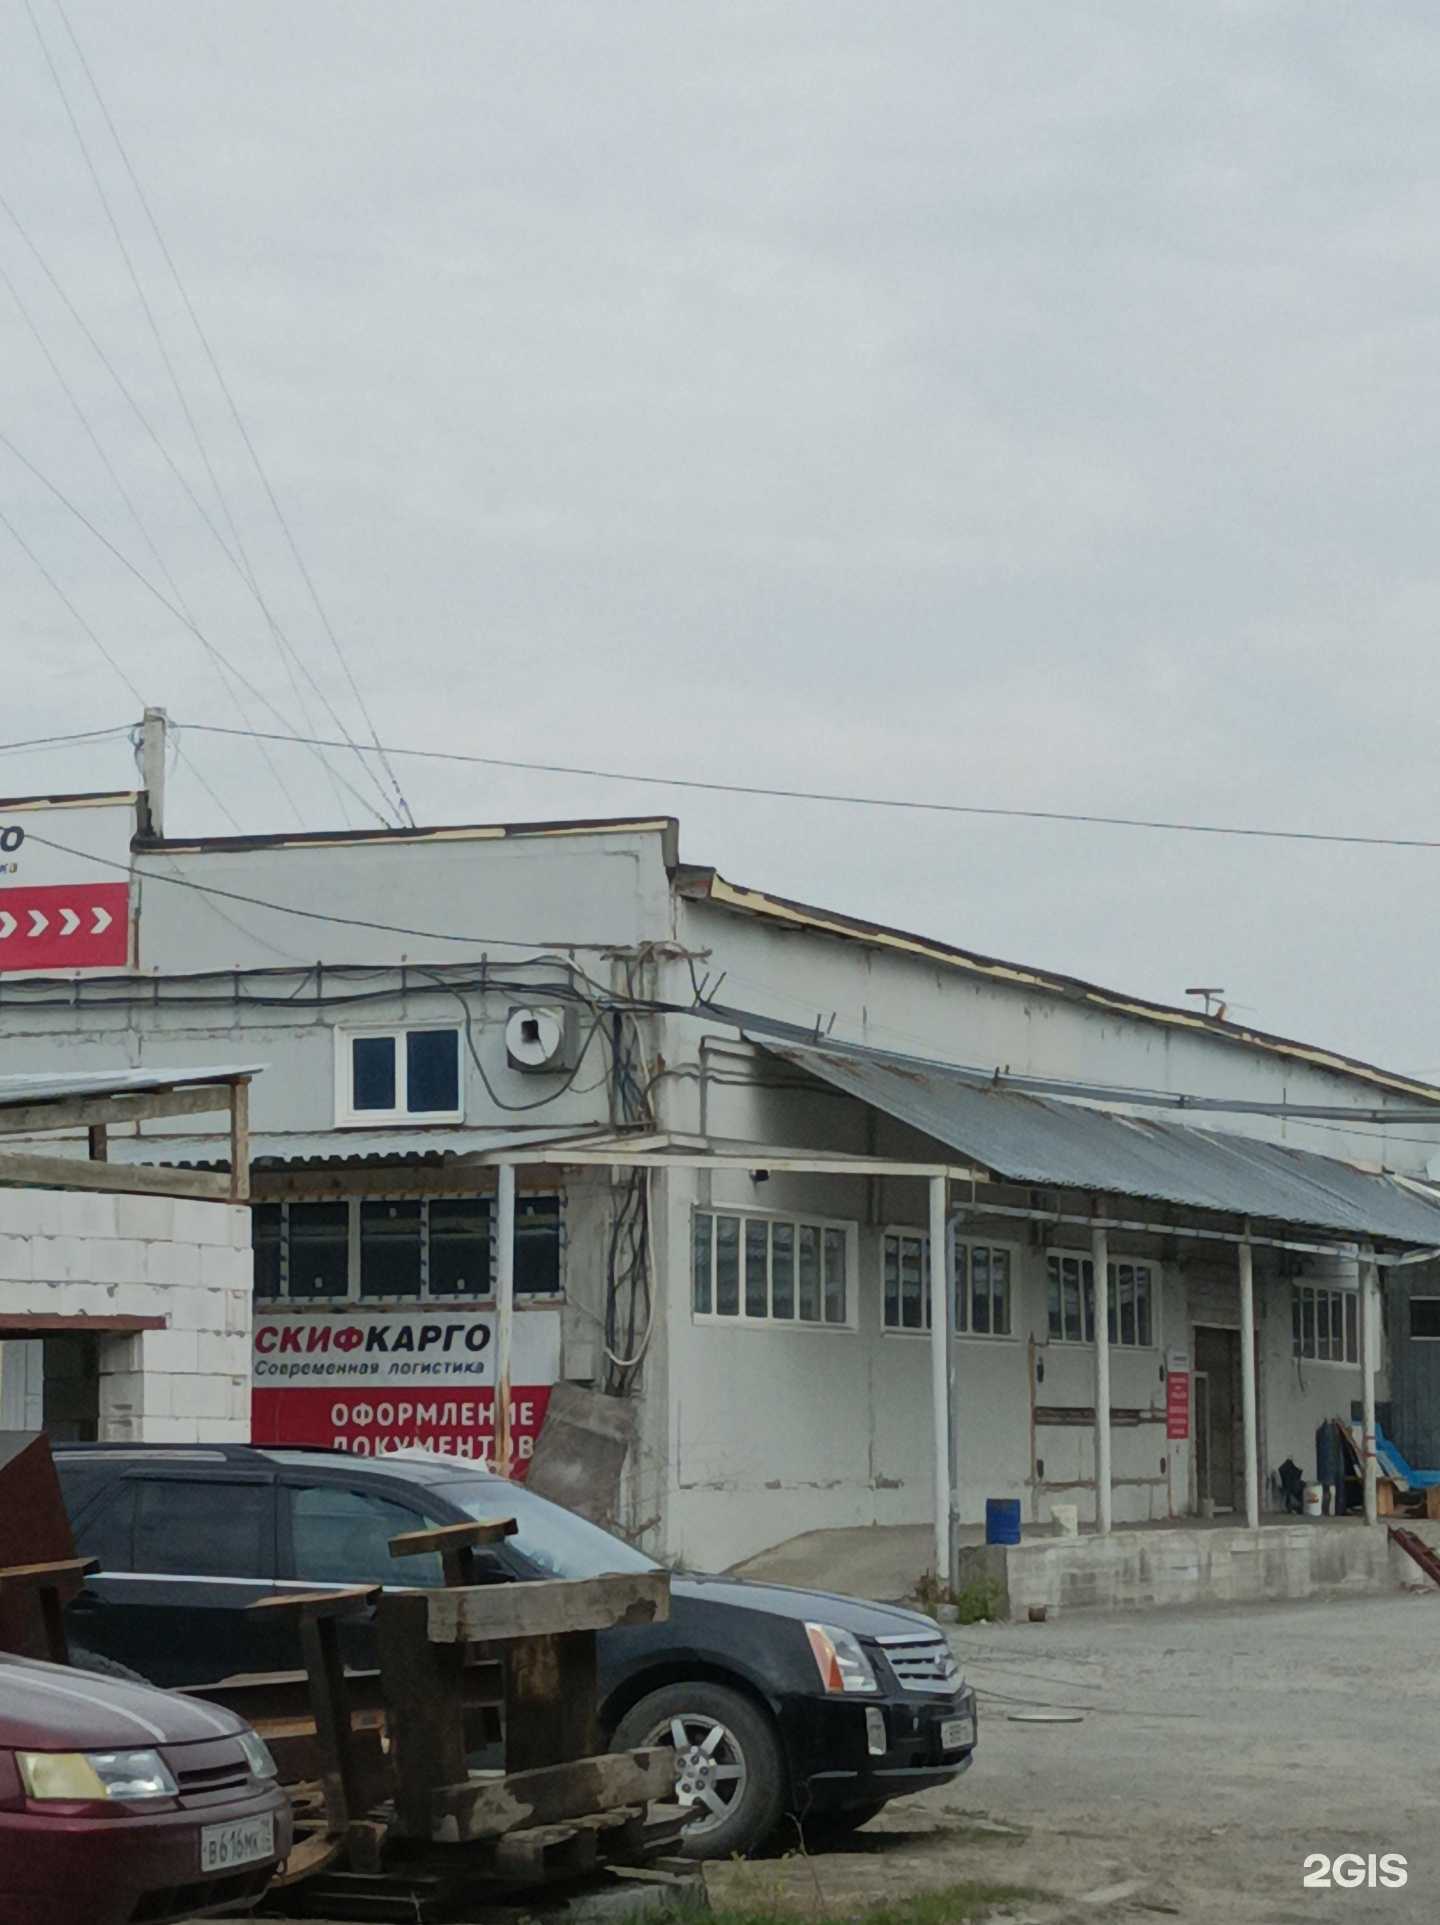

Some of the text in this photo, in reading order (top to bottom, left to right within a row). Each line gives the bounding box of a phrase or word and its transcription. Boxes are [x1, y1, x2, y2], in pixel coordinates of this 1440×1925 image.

[254, 1323, 491, 1354] СКИФКАРГО
[254, 1359, 485, 1379] Современная логистика
[333, 1435, 534, 1460] ДОКУМЕНТВ
